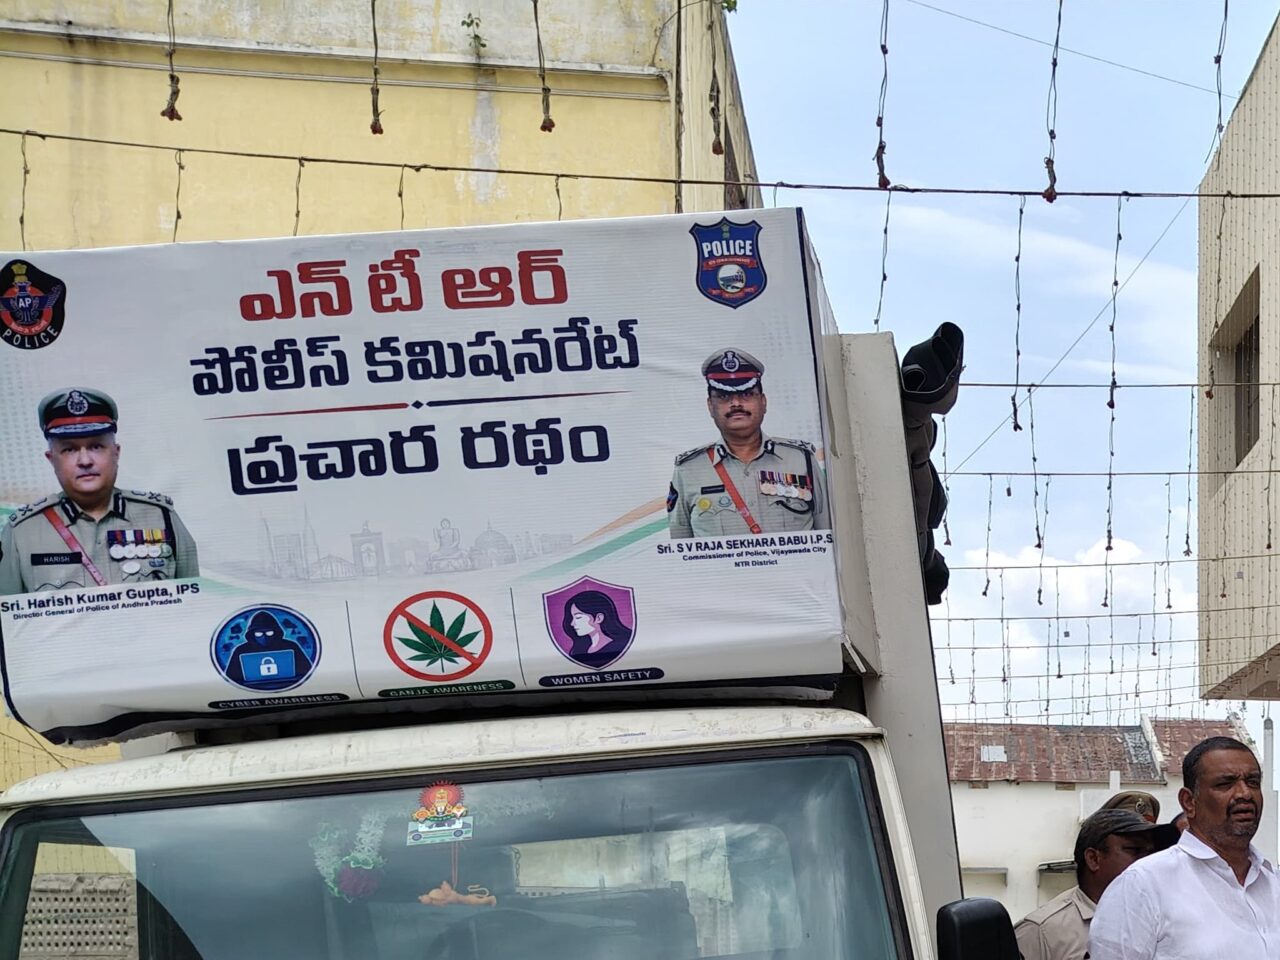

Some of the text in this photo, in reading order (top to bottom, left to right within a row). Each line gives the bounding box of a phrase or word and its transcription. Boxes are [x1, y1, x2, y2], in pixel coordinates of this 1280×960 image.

[702, 239, 752, 258] POLICE
[240, 249, 568, 321] ఎన్ టీ ఆర్
[18, 297, 32, 308] AP
[2, 325, 58, 348] POLICE
[190, 316, 640, 396] పోలీస్ కమిషనరేట్
[227, 417, 610, 496] ప్రచార రథం
[656, 544, 675, 554] Sri.
[676, 543, 684, 553] S
[685, 542, 693, 552] V
[695, 540, 724, 552] RAJA
[725, 537, 777, 550] SEKHARA
[778, 535, 808, 547] BABU
[682, 552, 735, 561] Commissioner
[770, 546, 811, 556] Vijayawada
[812, 546, 827, 554] City
[43, 555, 70, 563] HARISH
[734, 559, 778, 568] NTR District
[0, 583, 200, 613] Sri. Harish Kumar Gupta, IPS
[13, 611, 43, 620] Director
[44, 608, 75, 617] General
[85, 602, 110, 611] Police
[111, 602, 120, 610] of
[121, 600, 149, 609] Andhra
[150, 597, 183, 606] Pradesh
[551, 670, 653, 686] WOMEN SAFETY
[433, 683, 505, 694] AWARENESS
[219, 694, 340, 708] CYBER AWARENESS
